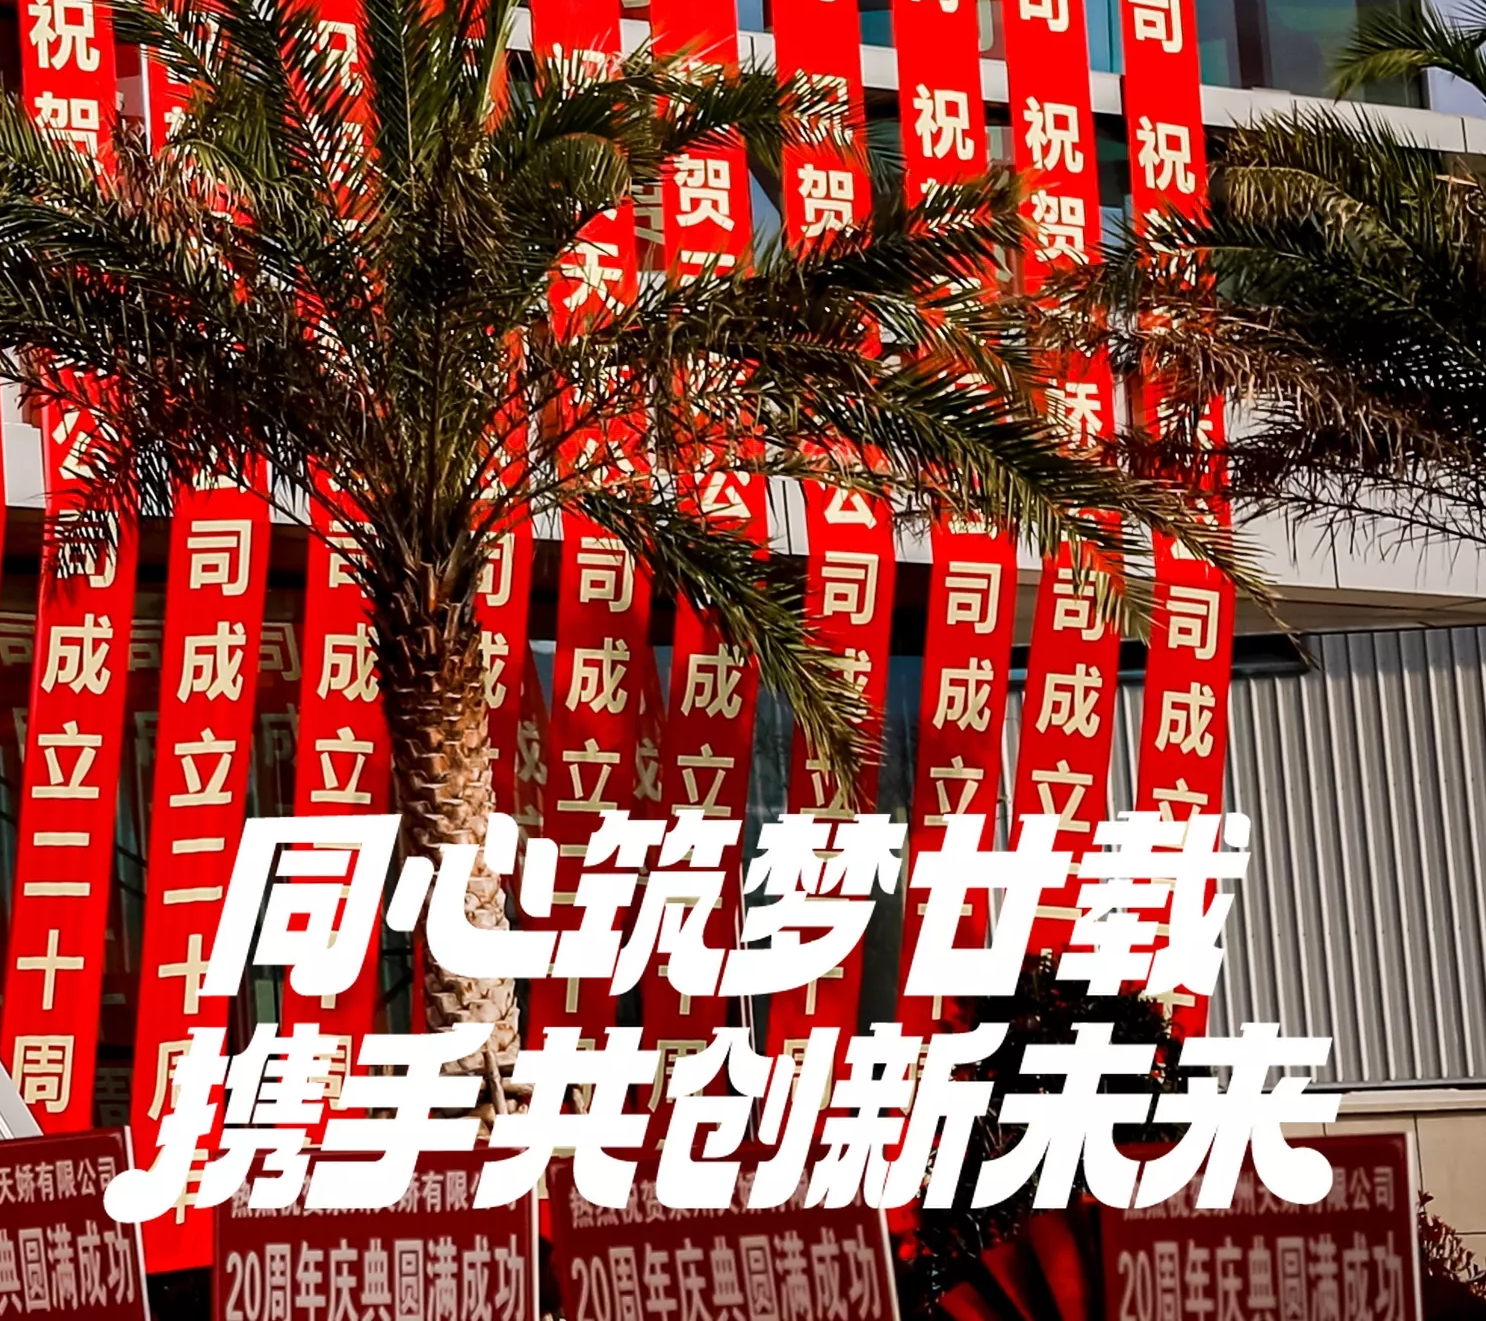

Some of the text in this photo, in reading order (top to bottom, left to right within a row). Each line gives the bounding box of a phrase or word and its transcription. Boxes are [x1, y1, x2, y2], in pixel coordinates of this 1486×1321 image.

[224, 1233, 523, 1321] 20周年庆典圆满成功
[569, 1224, 884, 1321] 20周年庆典圆满成功
